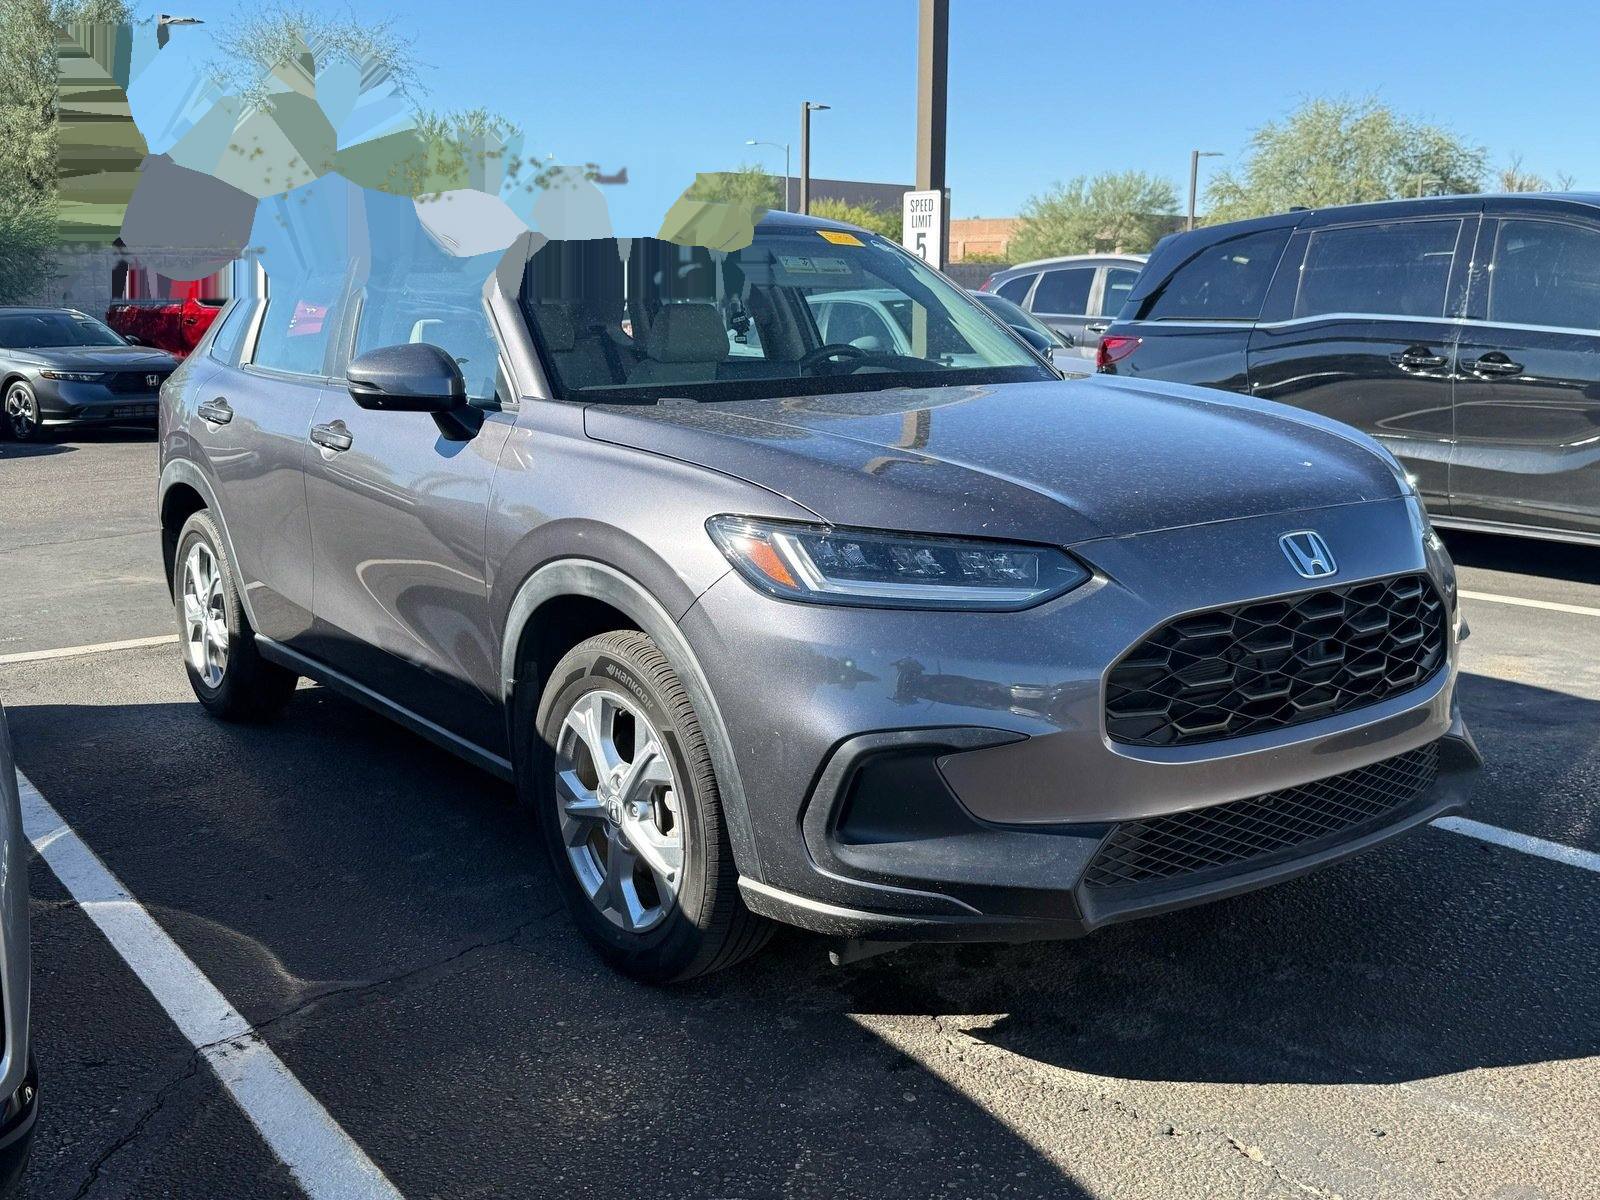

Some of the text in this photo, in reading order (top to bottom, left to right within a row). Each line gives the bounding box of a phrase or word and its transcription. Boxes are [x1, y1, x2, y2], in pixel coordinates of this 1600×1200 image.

[910, 199, 933, 212] SPEED
[911, 215, 932, 228] LIMIT
[916, 233, 927, 261] 5
